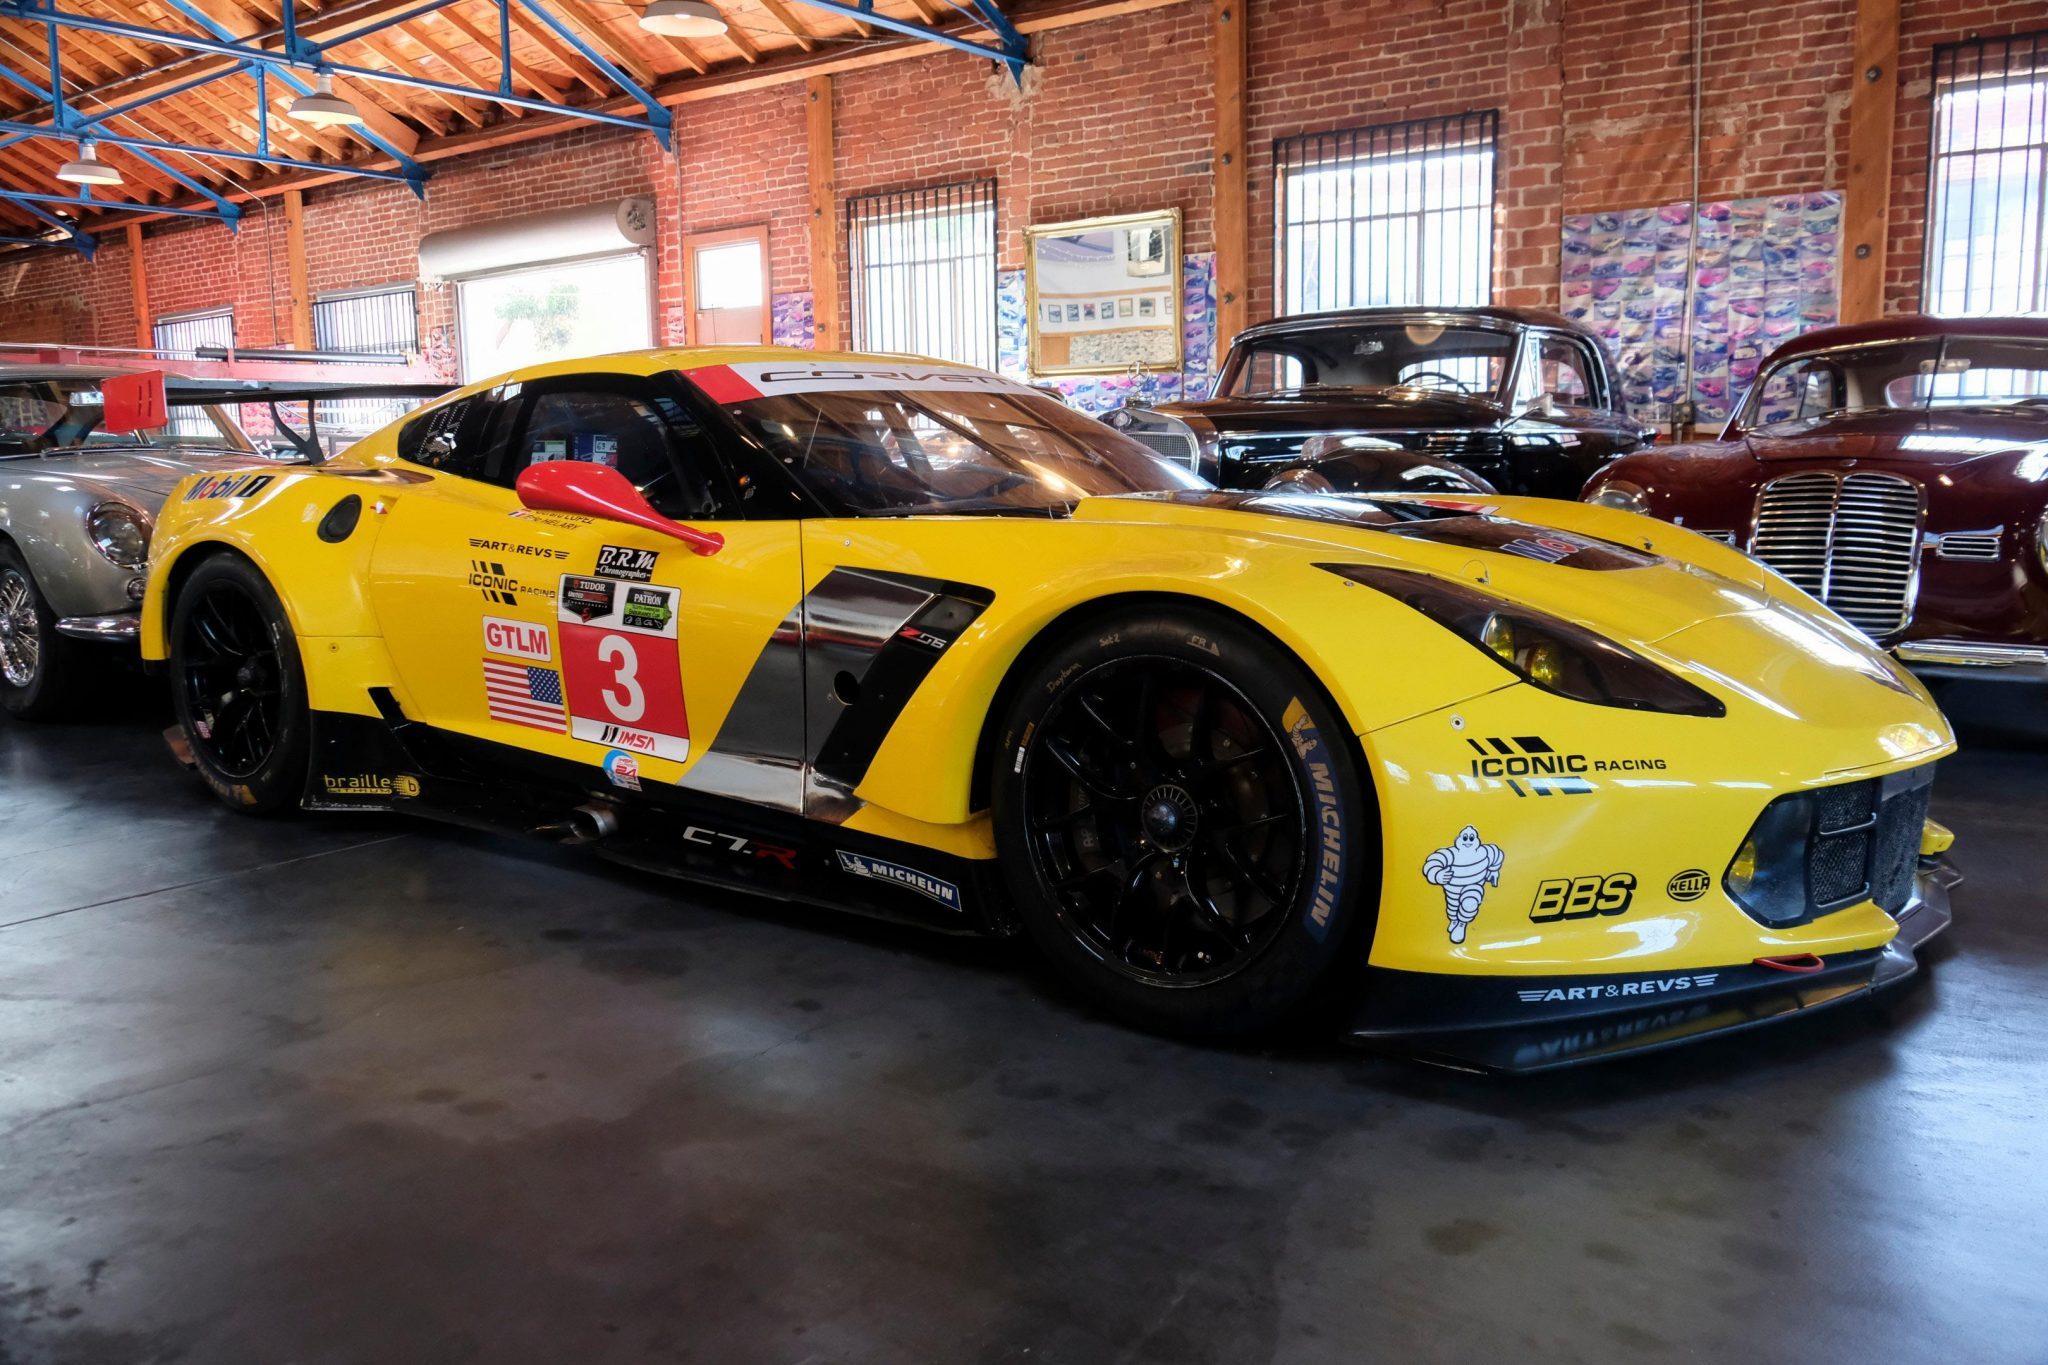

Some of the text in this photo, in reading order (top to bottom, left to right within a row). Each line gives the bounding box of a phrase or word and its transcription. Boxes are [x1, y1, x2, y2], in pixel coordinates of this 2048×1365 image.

[183, 475, 251, 500] Mobil
[481, 540, 552, 558] ART&REVS
[469, 573, 556, 598] ICONIC RACING
[580, 581, 606, 592] TUDOR
[486, 623, 548, 655] GTLM
[598, 635, 645, 722] 3
[618, 731, 655, 751] IMSA
[1472, 755, 1667, 778] ICONIC RACING
[324, 774, 391, 788] braille
[1309, 762, 1341, 928] MICHELIN
[872, 863, 954, 901] MICHELIN
[1670, 876, 1711, 891] HELLA
[1529, 872, 1637, 924] BBS
[1544, 976, 1693, 1001] ART&REVS
